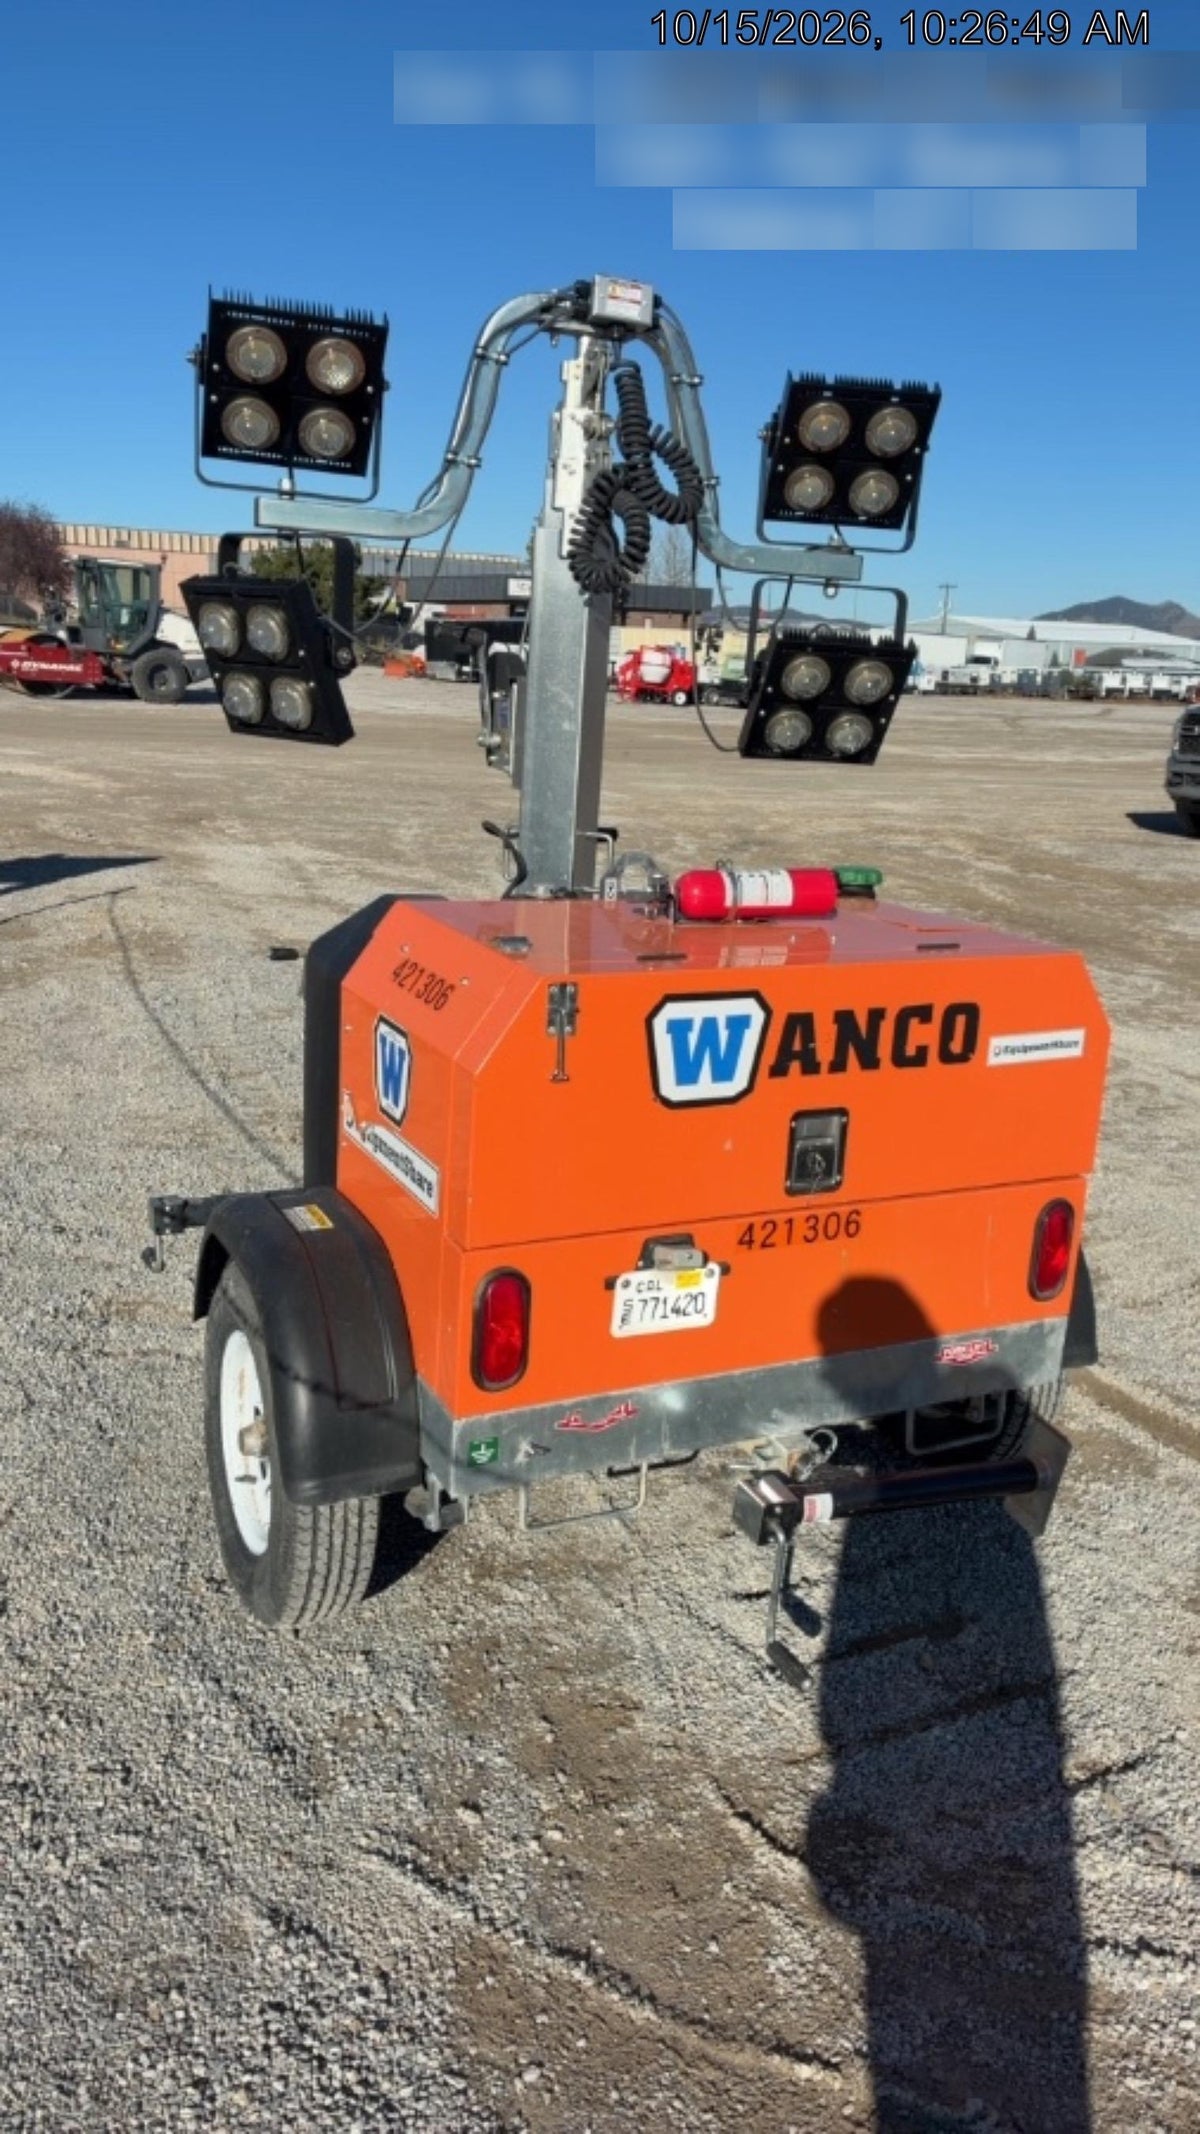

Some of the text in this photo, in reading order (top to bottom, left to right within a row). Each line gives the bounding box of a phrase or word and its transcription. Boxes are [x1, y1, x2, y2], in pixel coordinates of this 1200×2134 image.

[392, 957, 456, 1011] 421306
[379, 1032, 406, 1109] W
[665, 1002, 981, 1088] WANCO
[737, 1209, 861, 1252] 421306
[637, 1291, 706, 1322] 771420
